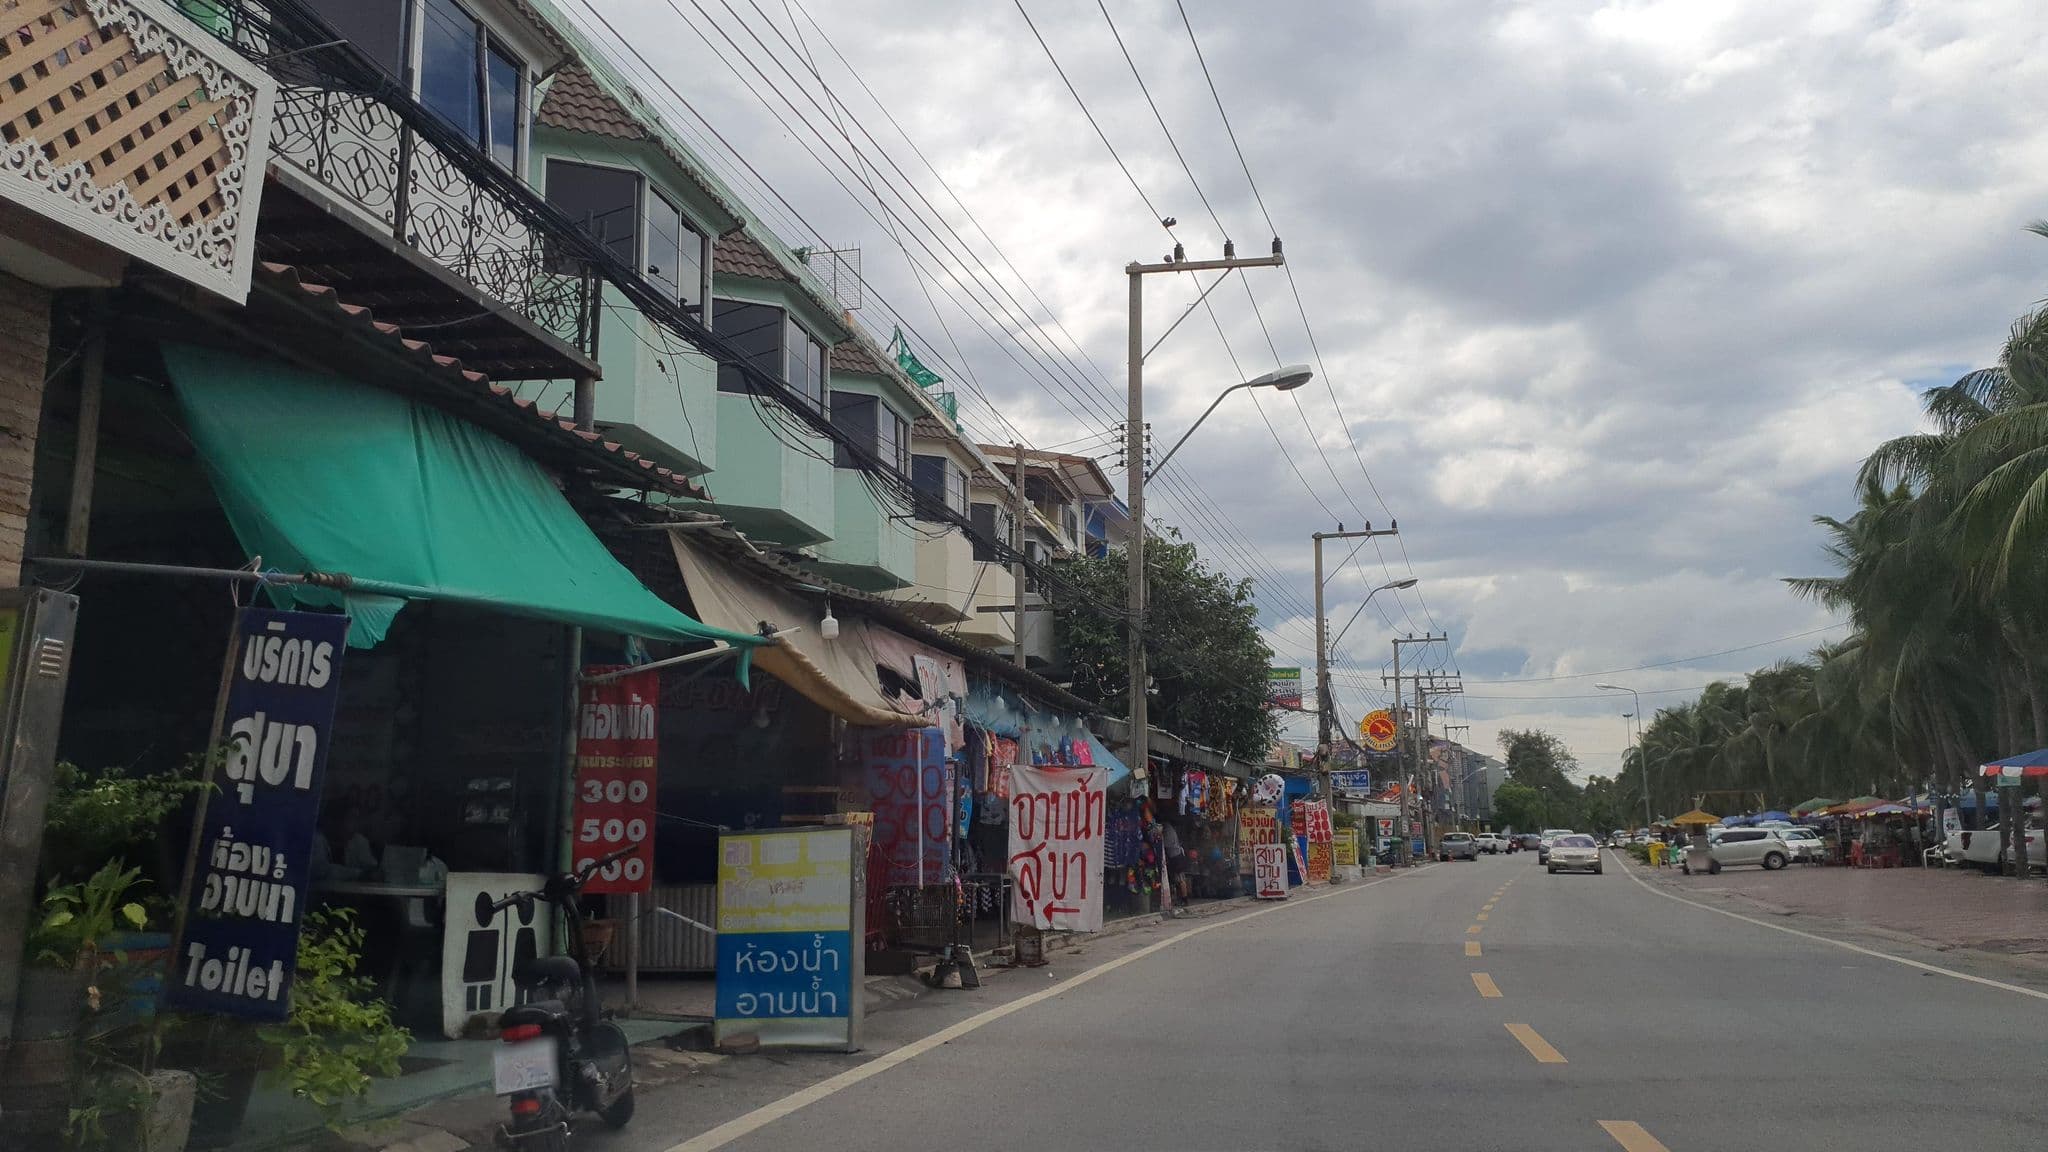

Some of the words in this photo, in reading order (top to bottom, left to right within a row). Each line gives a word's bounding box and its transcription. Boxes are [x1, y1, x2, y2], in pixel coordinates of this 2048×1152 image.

[243, 621, 333, 690] บริการ
[226, 711, 318, 805] สุขา
[581, 779, 648, 803] 300
[1013, 773, 1103, 841] อาบน้ำ
[210, 826, 269, 871] ห้อง
[579, 818, 647, 843] 500
[200, 853, 296, 926] อาบน้ำ
[1010, 841, 1087, 915] สุขา
[183, 941, 285, 1002] Toilet
[736, 933, 840, 973] ห้องน้ำ
[736, 976, 837, 1015] อาบน้ำ
